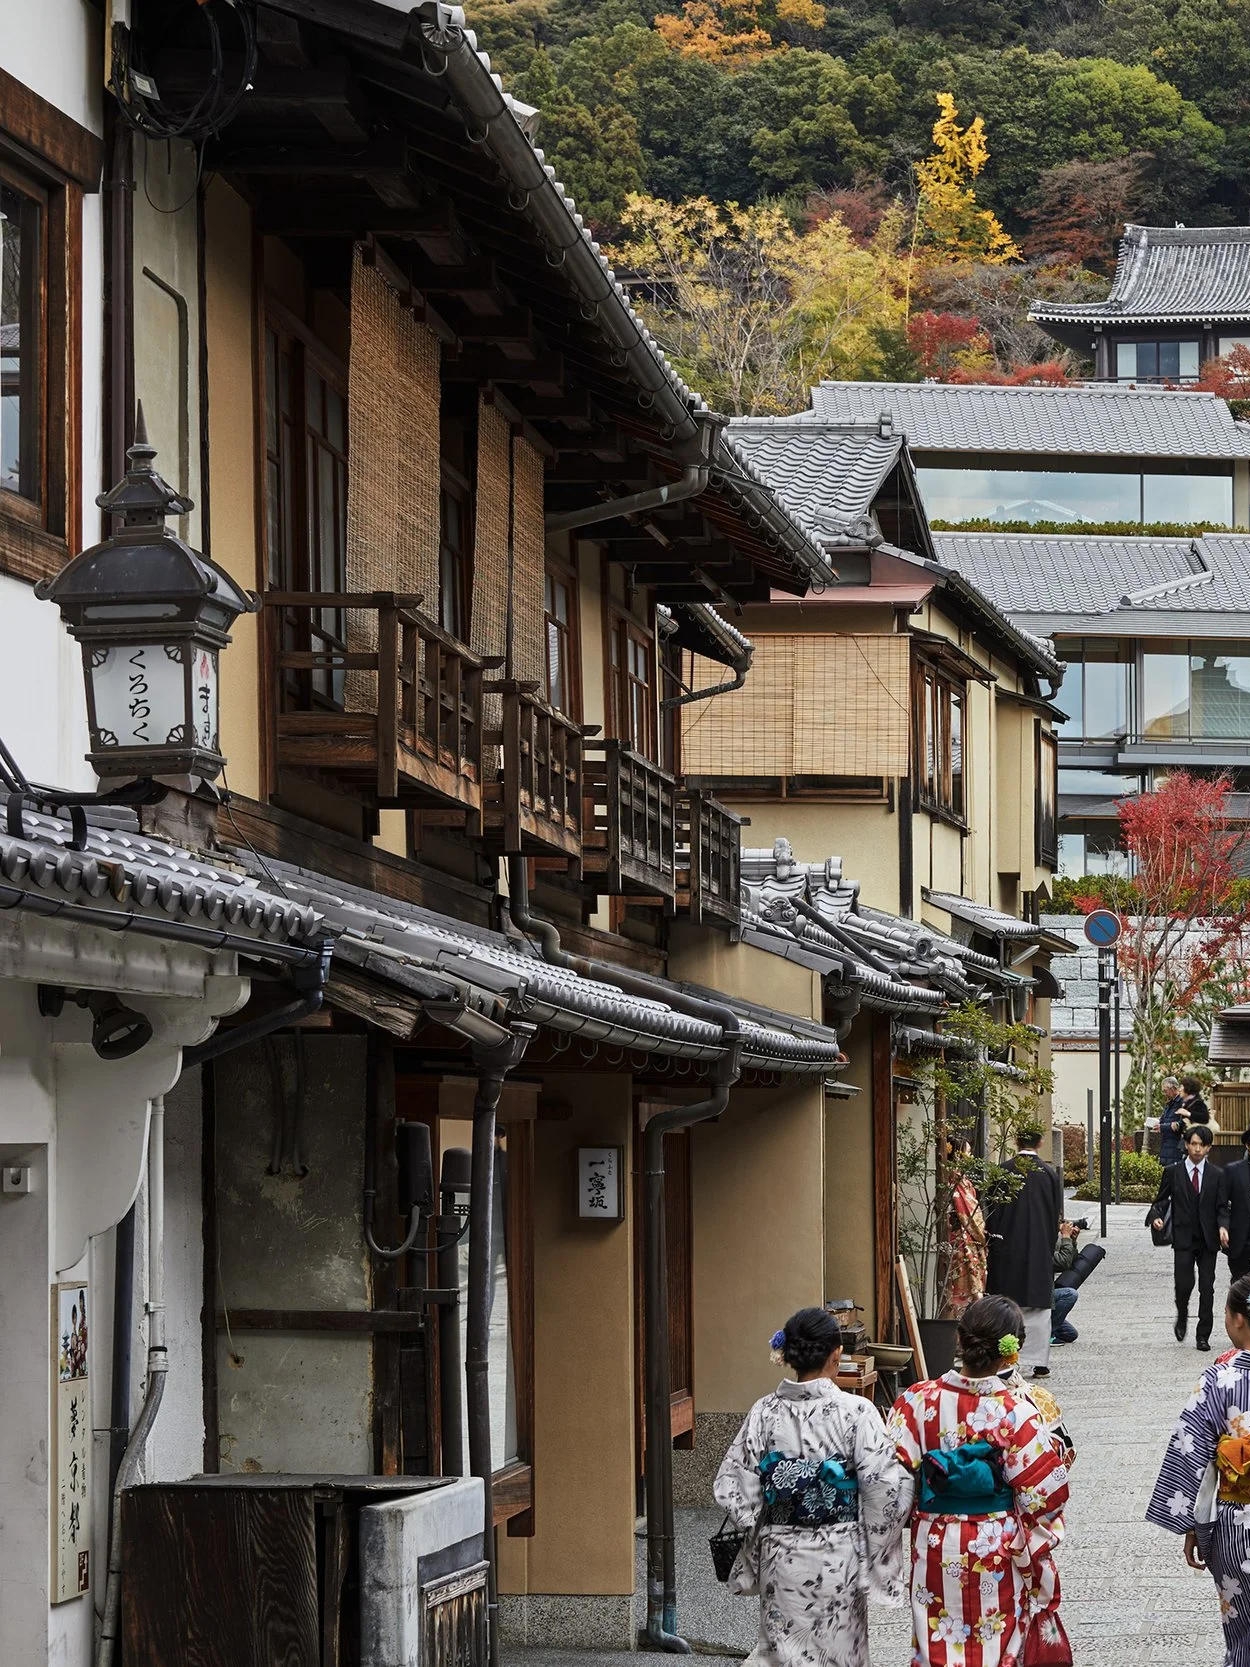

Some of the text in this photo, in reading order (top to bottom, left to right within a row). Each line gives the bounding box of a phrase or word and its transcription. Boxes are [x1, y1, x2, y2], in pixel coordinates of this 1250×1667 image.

[128, 649, 151, 742] くろちく
[68, 1395, 80, 1547] 夢京都
